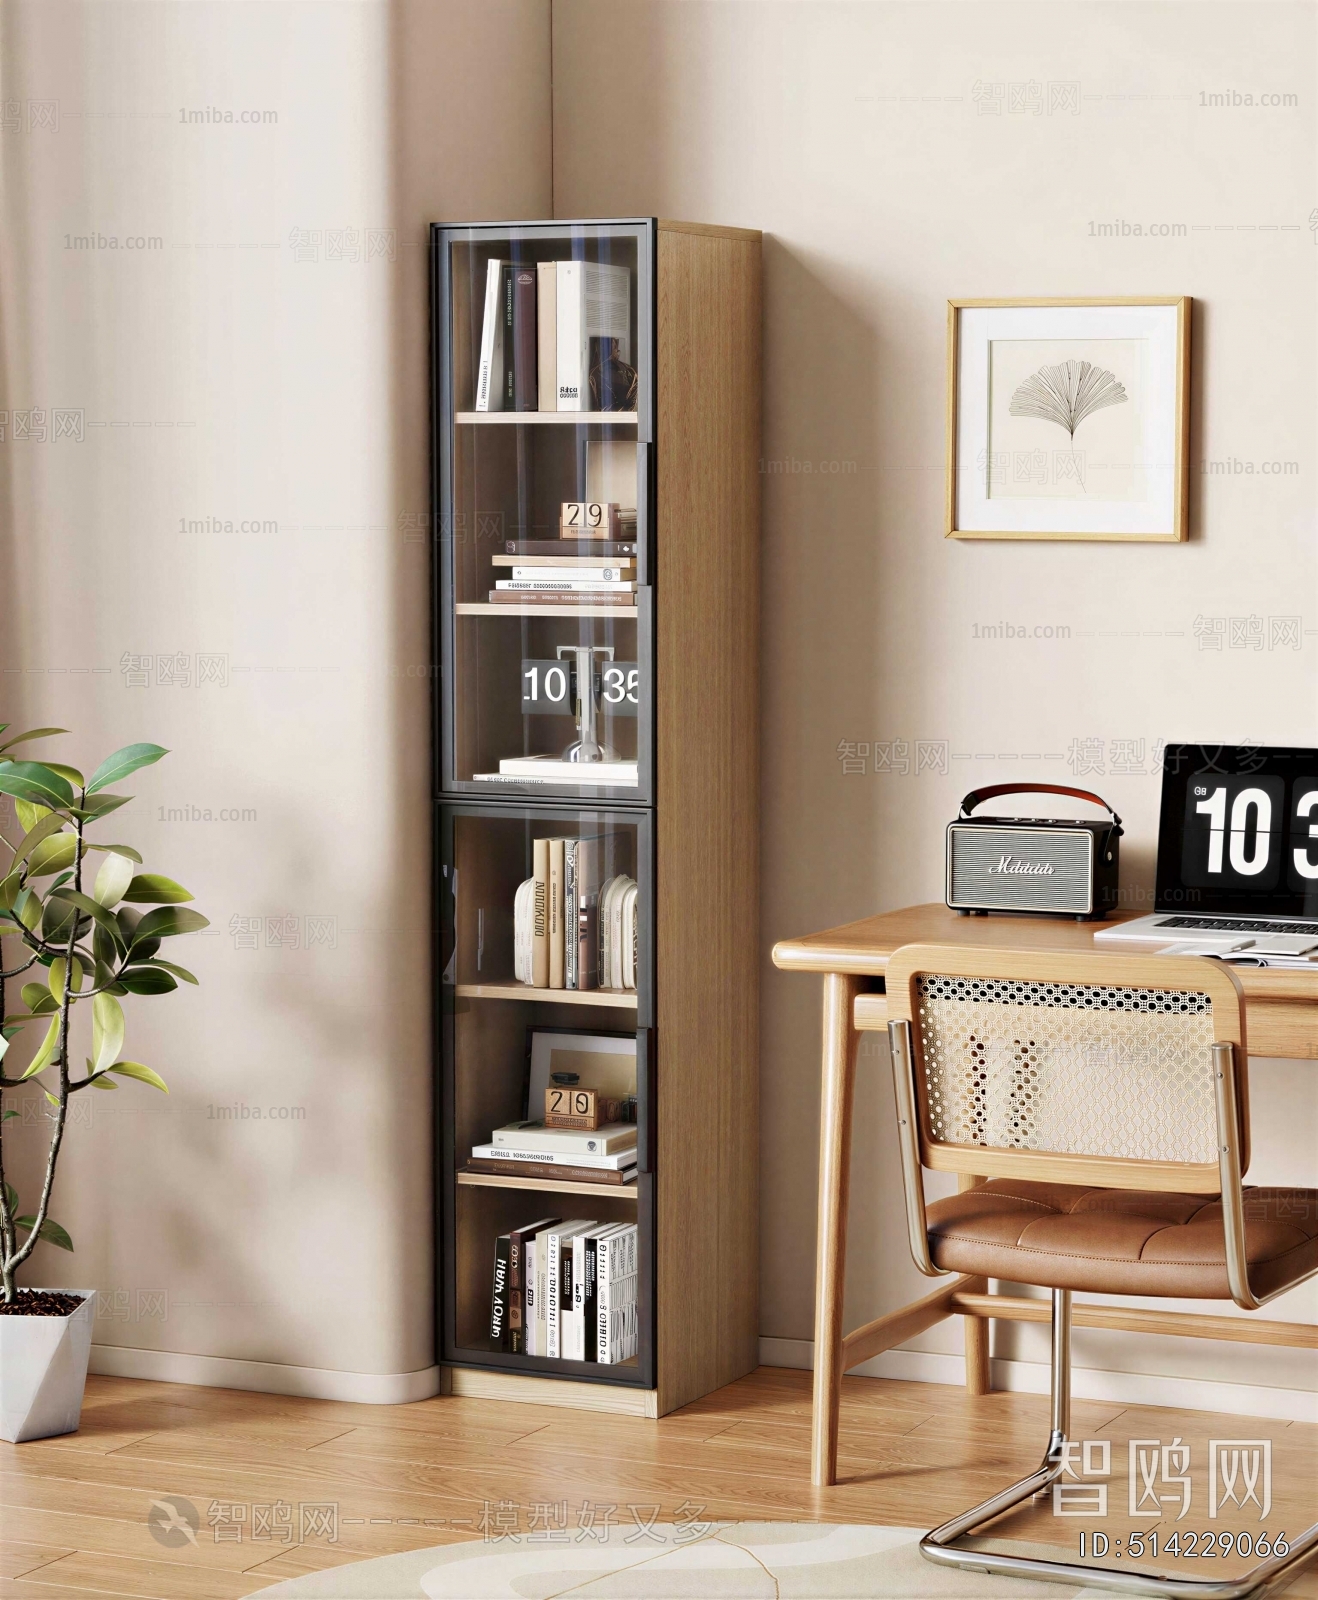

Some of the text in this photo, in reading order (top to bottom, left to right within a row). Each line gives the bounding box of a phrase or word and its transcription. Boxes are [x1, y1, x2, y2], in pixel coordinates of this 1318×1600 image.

[567, 503, 603, 528] 29
[524, 666, 567, 702] 10
[1196, 788, 1272, 876] 10
